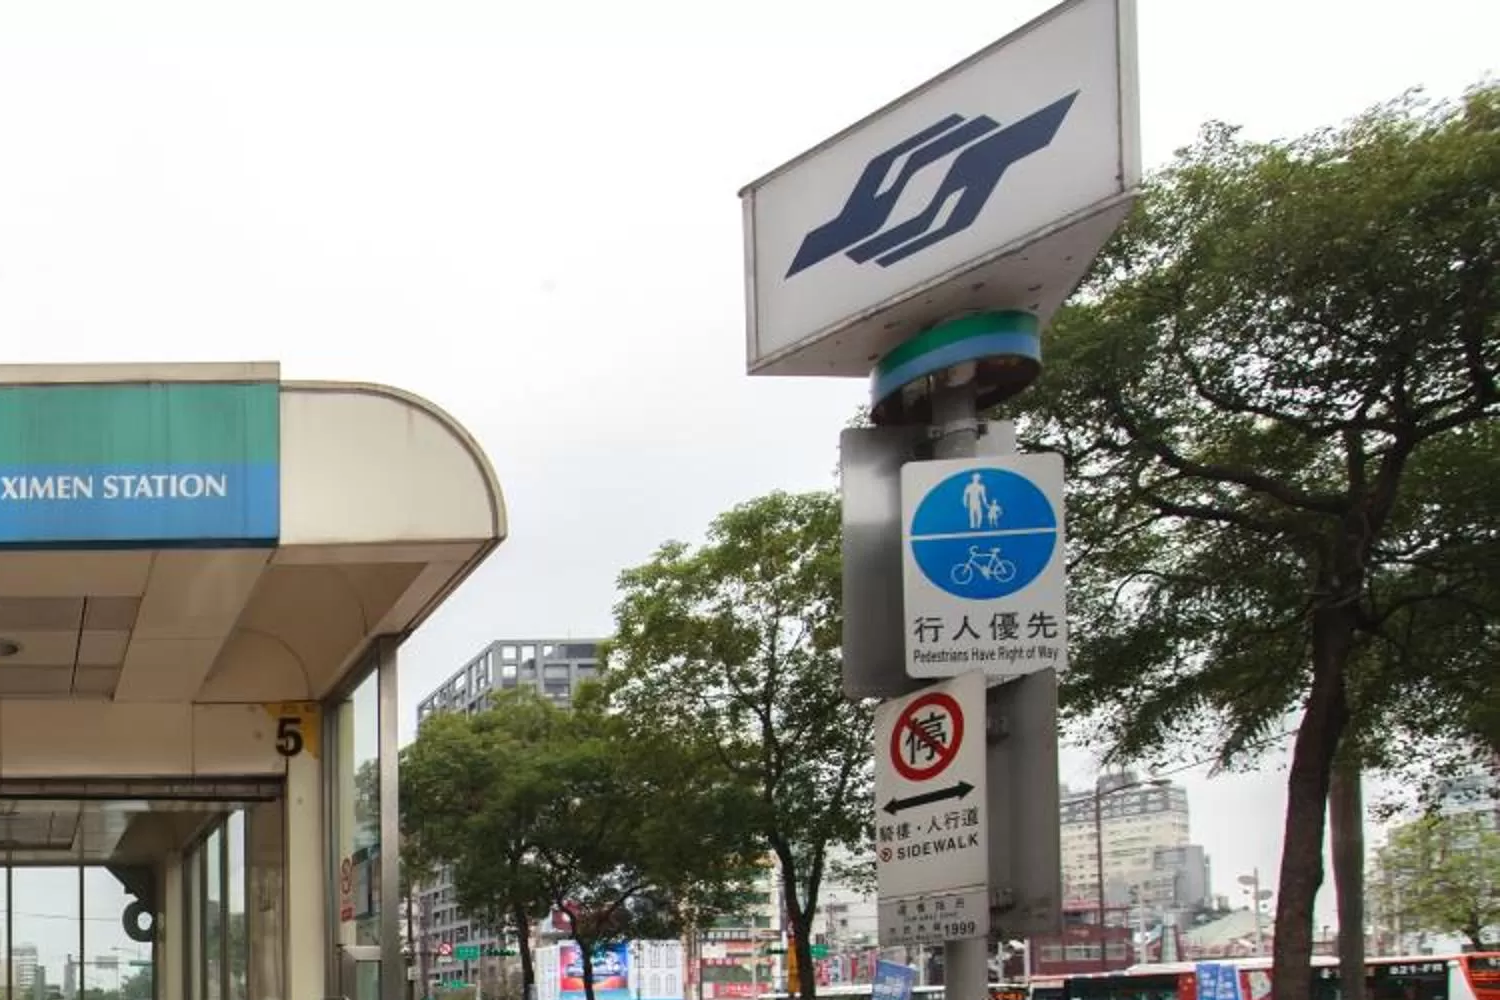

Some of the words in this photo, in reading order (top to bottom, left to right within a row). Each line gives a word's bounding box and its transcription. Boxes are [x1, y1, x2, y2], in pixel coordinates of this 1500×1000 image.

[1, 475, 94, 499] XIMEN
[103, 474, 228, 499] STATION
[913, 610, 1059, 643] 行人優先
[913, 649, 969, 663] Pedestrians
[971, 647, 996, 661] Have
[276, 716, 303, 757] 5
[905, 711, 947, 765] 停
[897, 832, 979, 861] SIDEWALK
